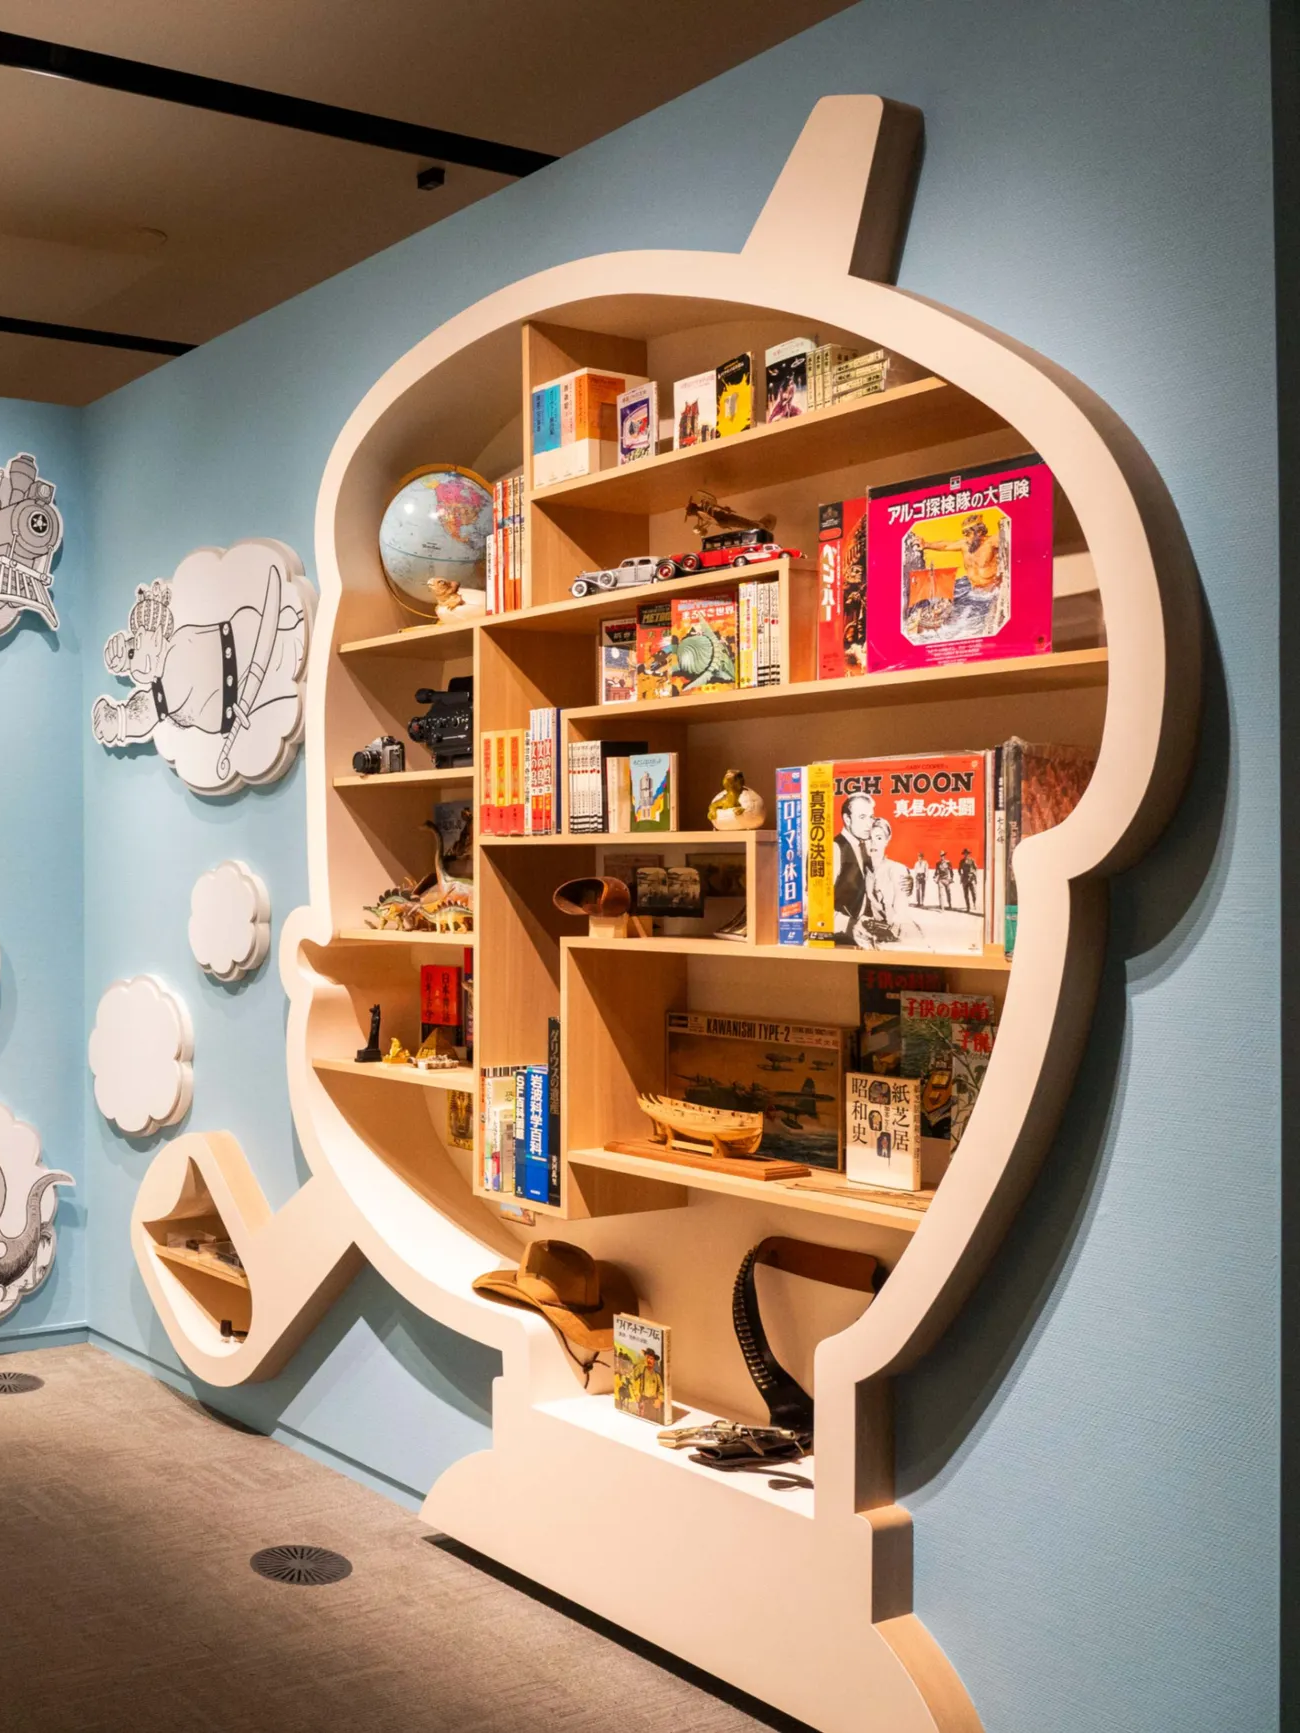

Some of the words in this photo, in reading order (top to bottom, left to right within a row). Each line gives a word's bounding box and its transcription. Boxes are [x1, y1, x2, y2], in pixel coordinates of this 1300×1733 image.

[887, 478, 1030, 525] アルゴ探検隊の大冒険
[821, 543, 837, 622] ベン・ハー
[833, 776, 882, 796] IGH
[890, 771, 974, 794] NOON
[894, 797, 976, 818] 真昼の決闘
[783, 801, 798, 901] ローマの休日
[809, 790, 826, 878] 真昼の決闘
[706, 1017, 756, 1039] KAWANISHI
[758, 1023, 791, 1043] TYPE-2
[851, 1077, 869, 1145] 昭和史
[891, 1082, 911, 1152] 紙芝居
